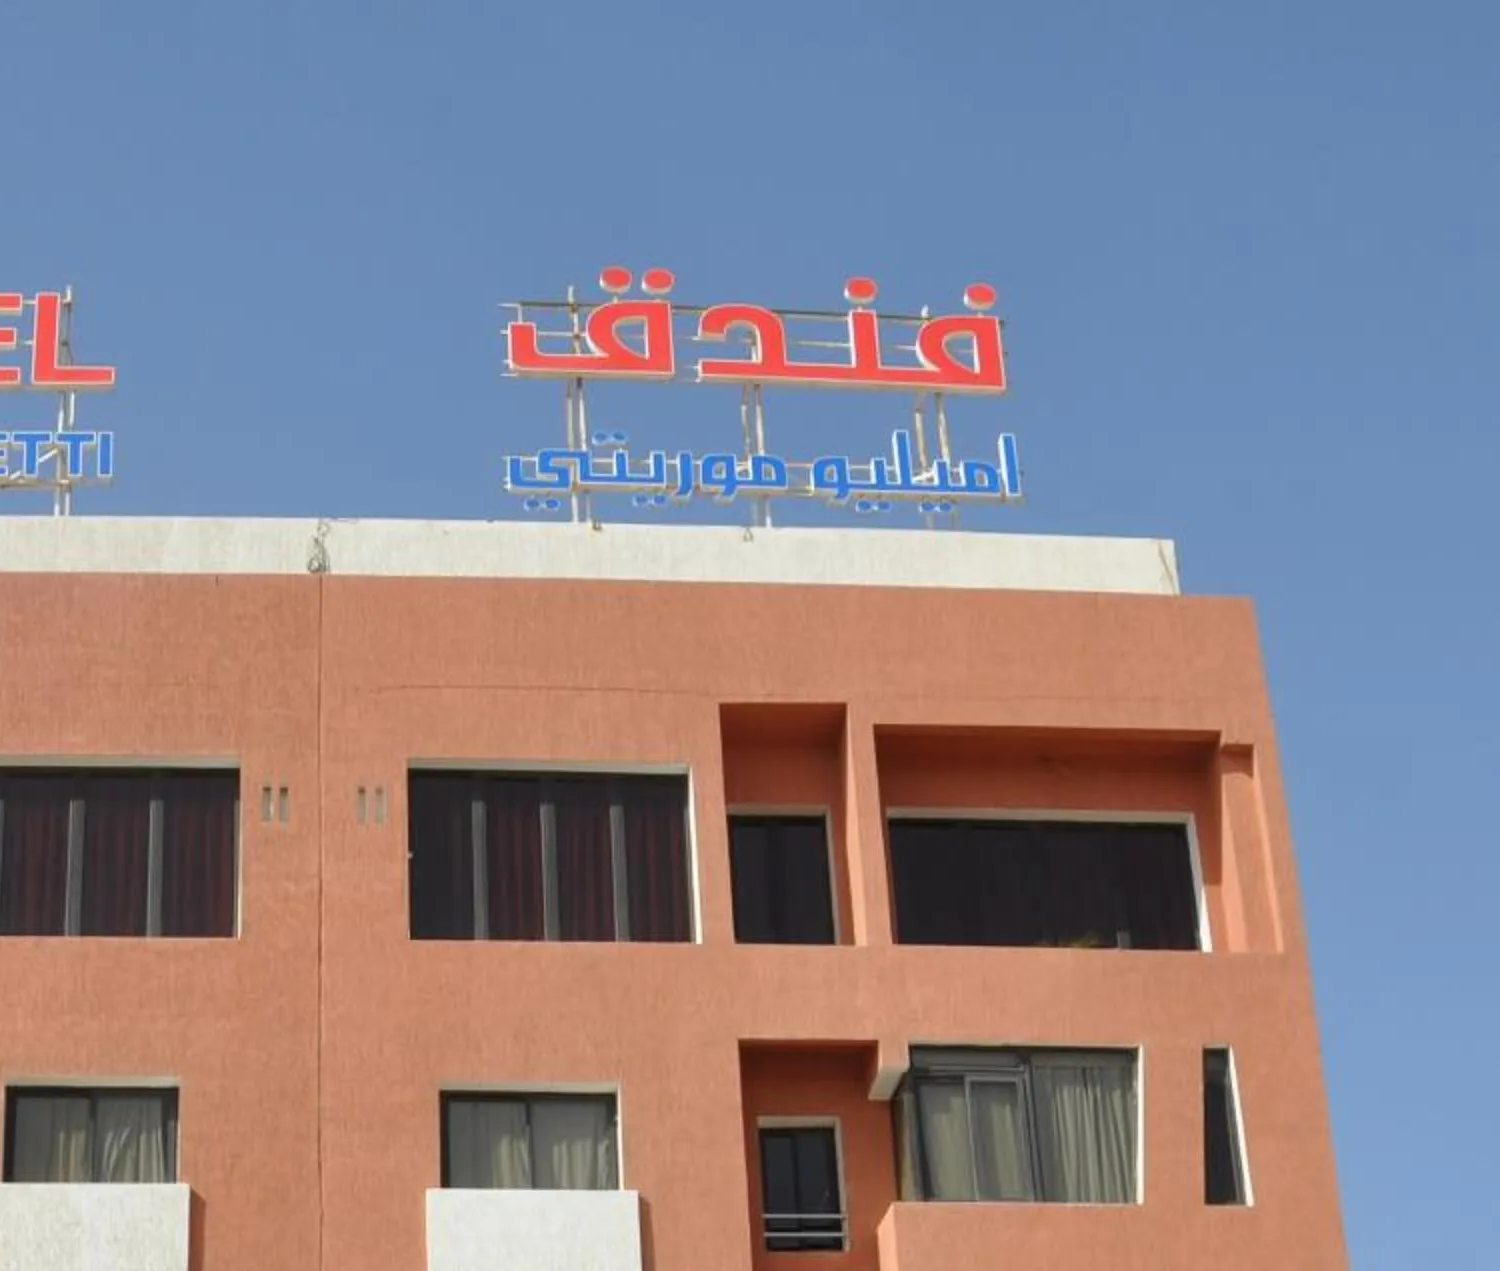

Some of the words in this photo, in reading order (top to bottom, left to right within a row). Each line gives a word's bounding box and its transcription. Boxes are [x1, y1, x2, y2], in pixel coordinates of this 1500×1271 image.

[507, 266, 1007, 391] فندق
[507, 430, 788, 511] موريتي
[811, 429, 1022, 513] اميليو
